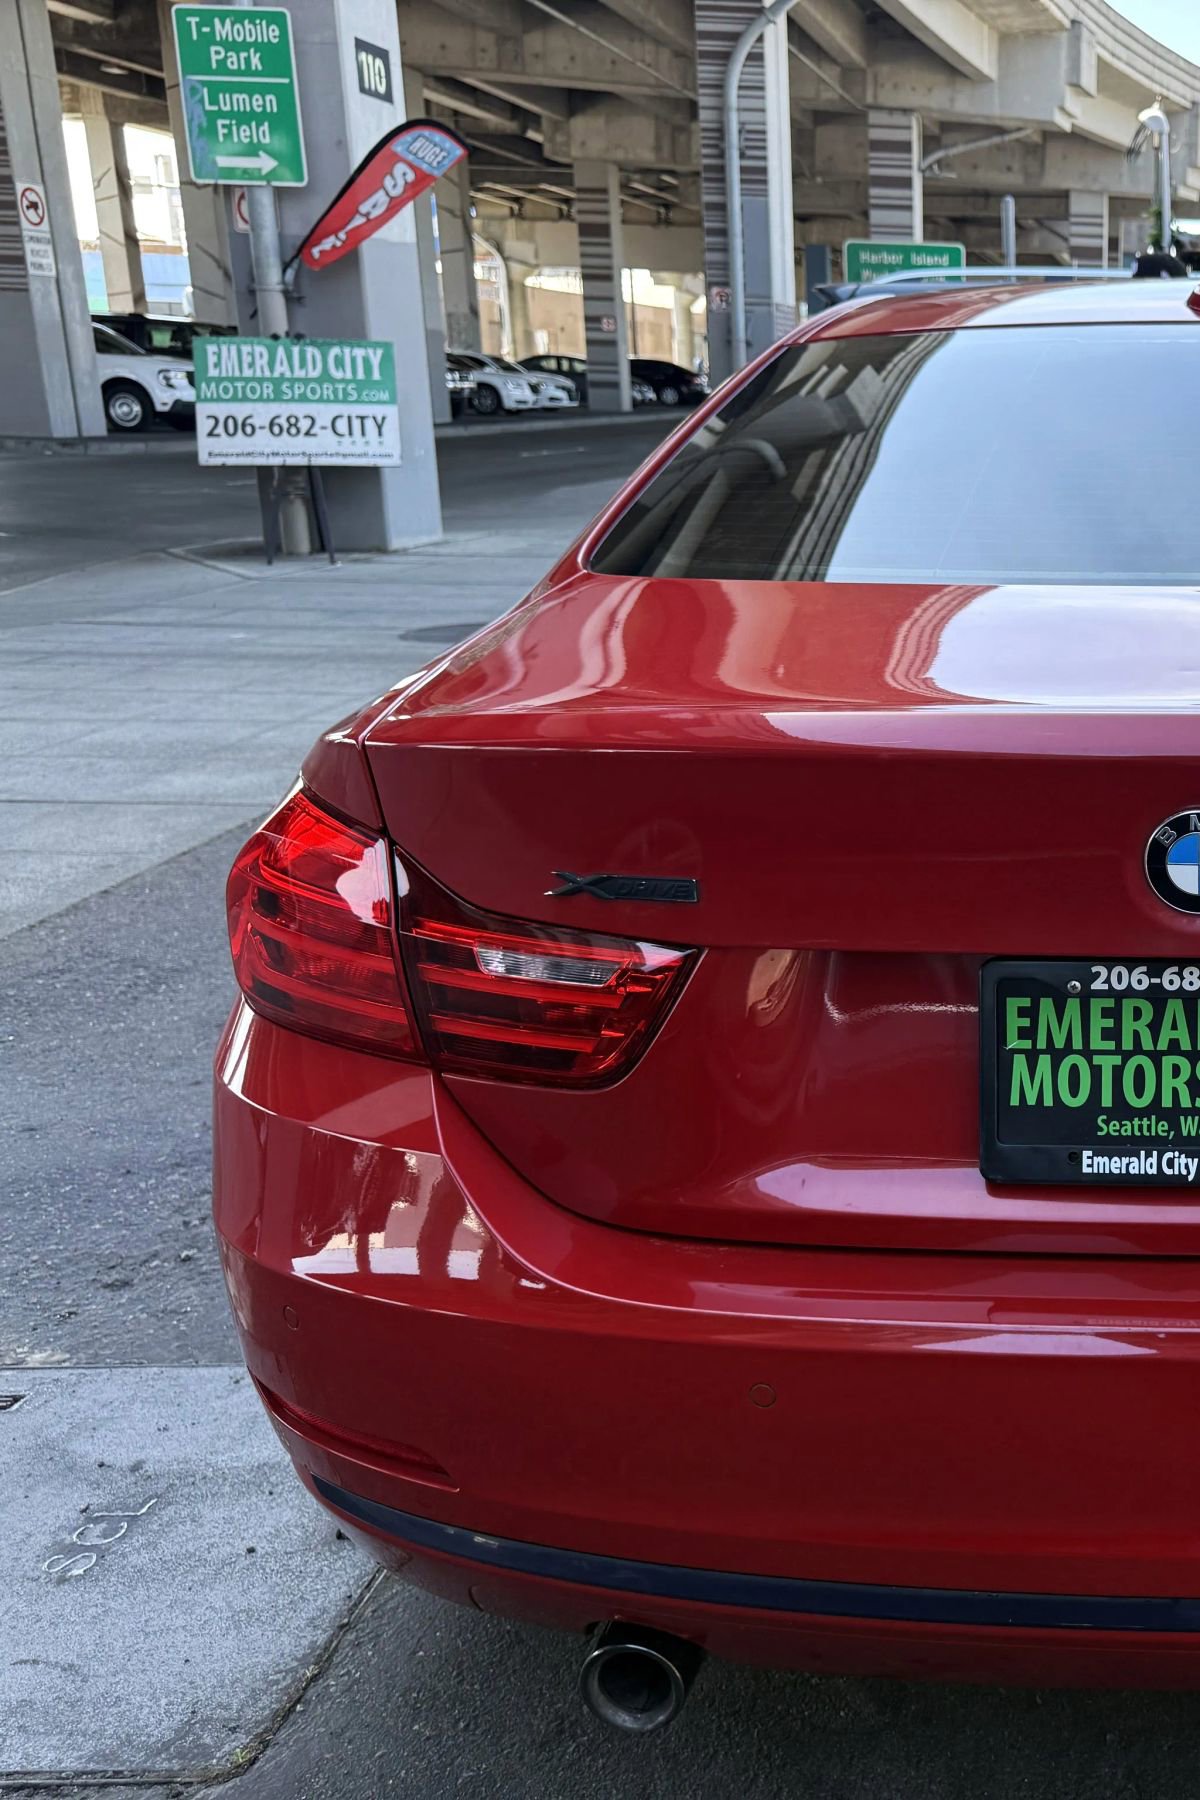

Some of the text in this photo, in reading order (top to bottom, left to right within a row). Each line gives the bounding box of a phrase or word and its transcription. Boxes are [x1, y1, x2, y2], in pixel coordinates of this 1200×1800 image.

[186, 16, 280, 43] T-Mobile
[209, 45, 263, 71] Park
[358, 51, 386, 95] 110
[203, 87, 278, 113] Lumen
[216, 119, 271, 144] Field
[407, 136, 448, 170] HUGE
[859, 250, 950, 266] Harbor Island
[206, 343, 384, 381] EMERALD CITY
[201, 381, 274, 400] MOTOR
[206, 414, 387, 438] 206-682-CITY
[1096, 1115, 1175, 1140] Seattle,
[1081, 1150, 1158, 1175] Emerald
[1161, 1152, 1199, 1182] City
